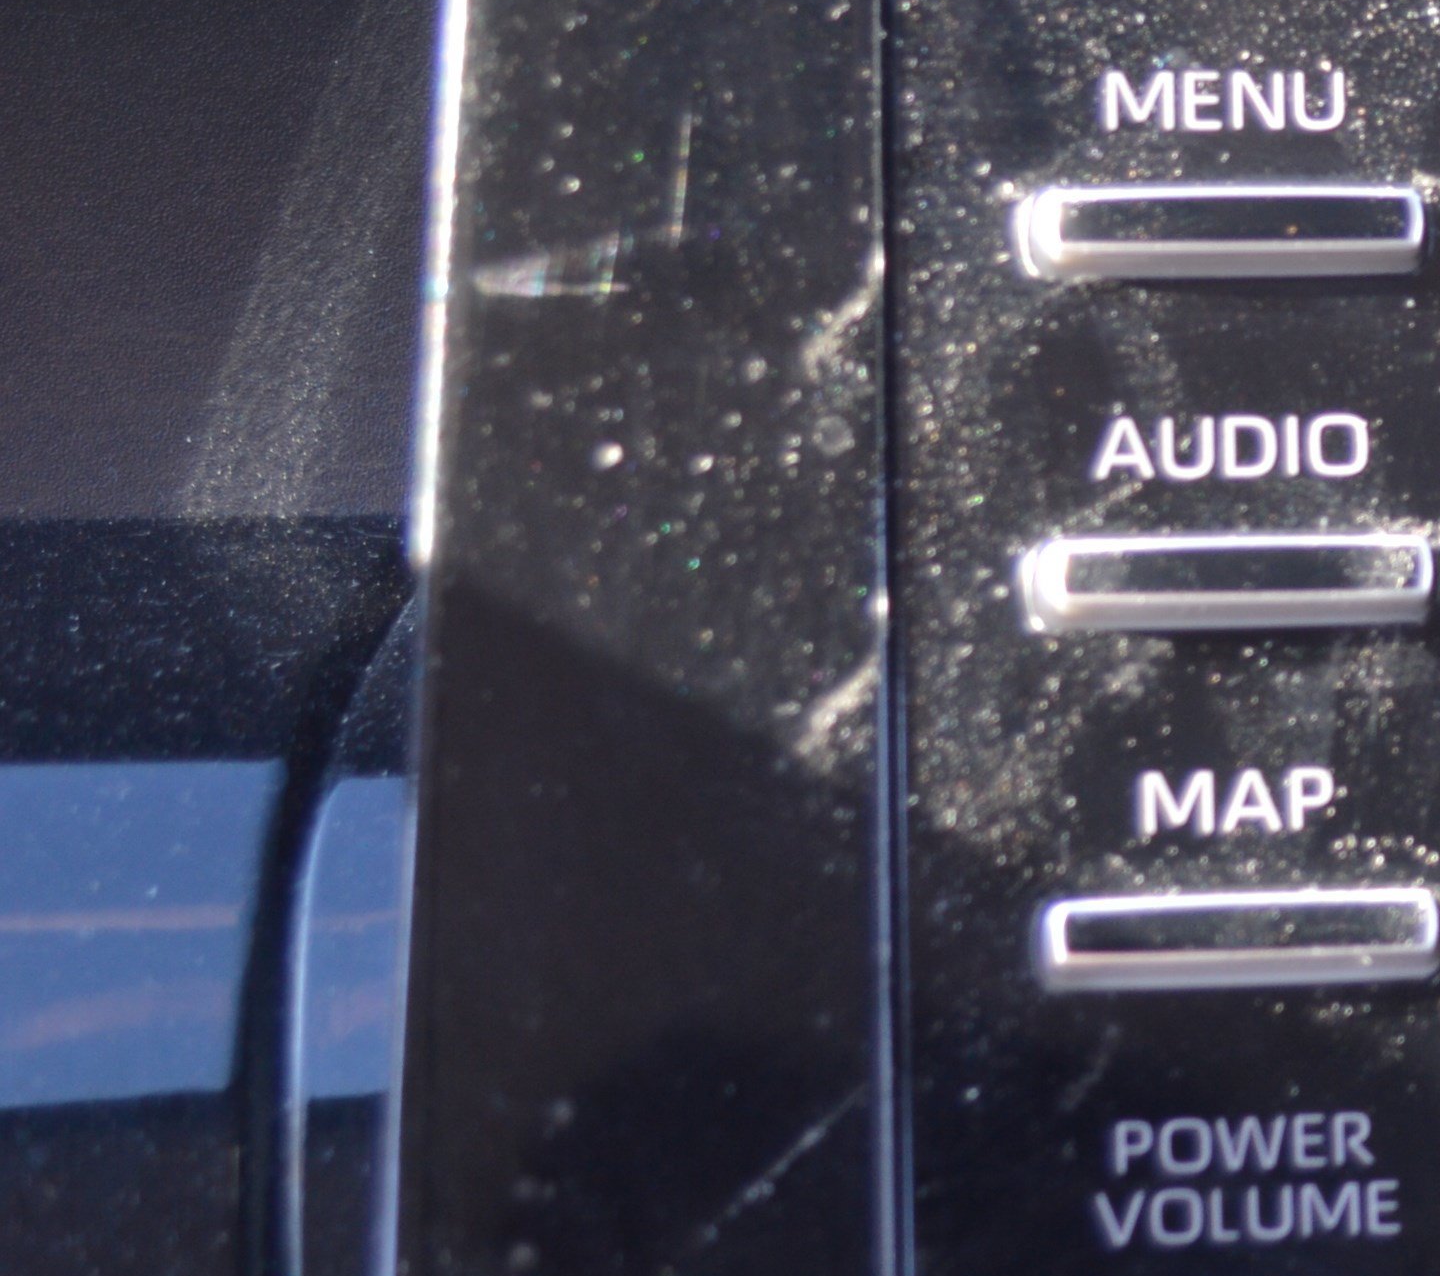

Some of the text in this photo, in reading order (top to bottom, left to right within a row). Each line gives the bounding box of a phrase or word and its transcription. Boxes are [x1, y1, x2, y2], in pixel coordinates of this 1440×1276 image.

[1101, 69, 1347, 132] MENU
[1092, 411, 1372, 482] AUDIO
[1137, 766, 1335, 836] MAP
[1112, 1111, 1376, 1177] POWER
[1094, 1178, 1402, 1249] VOLUME
